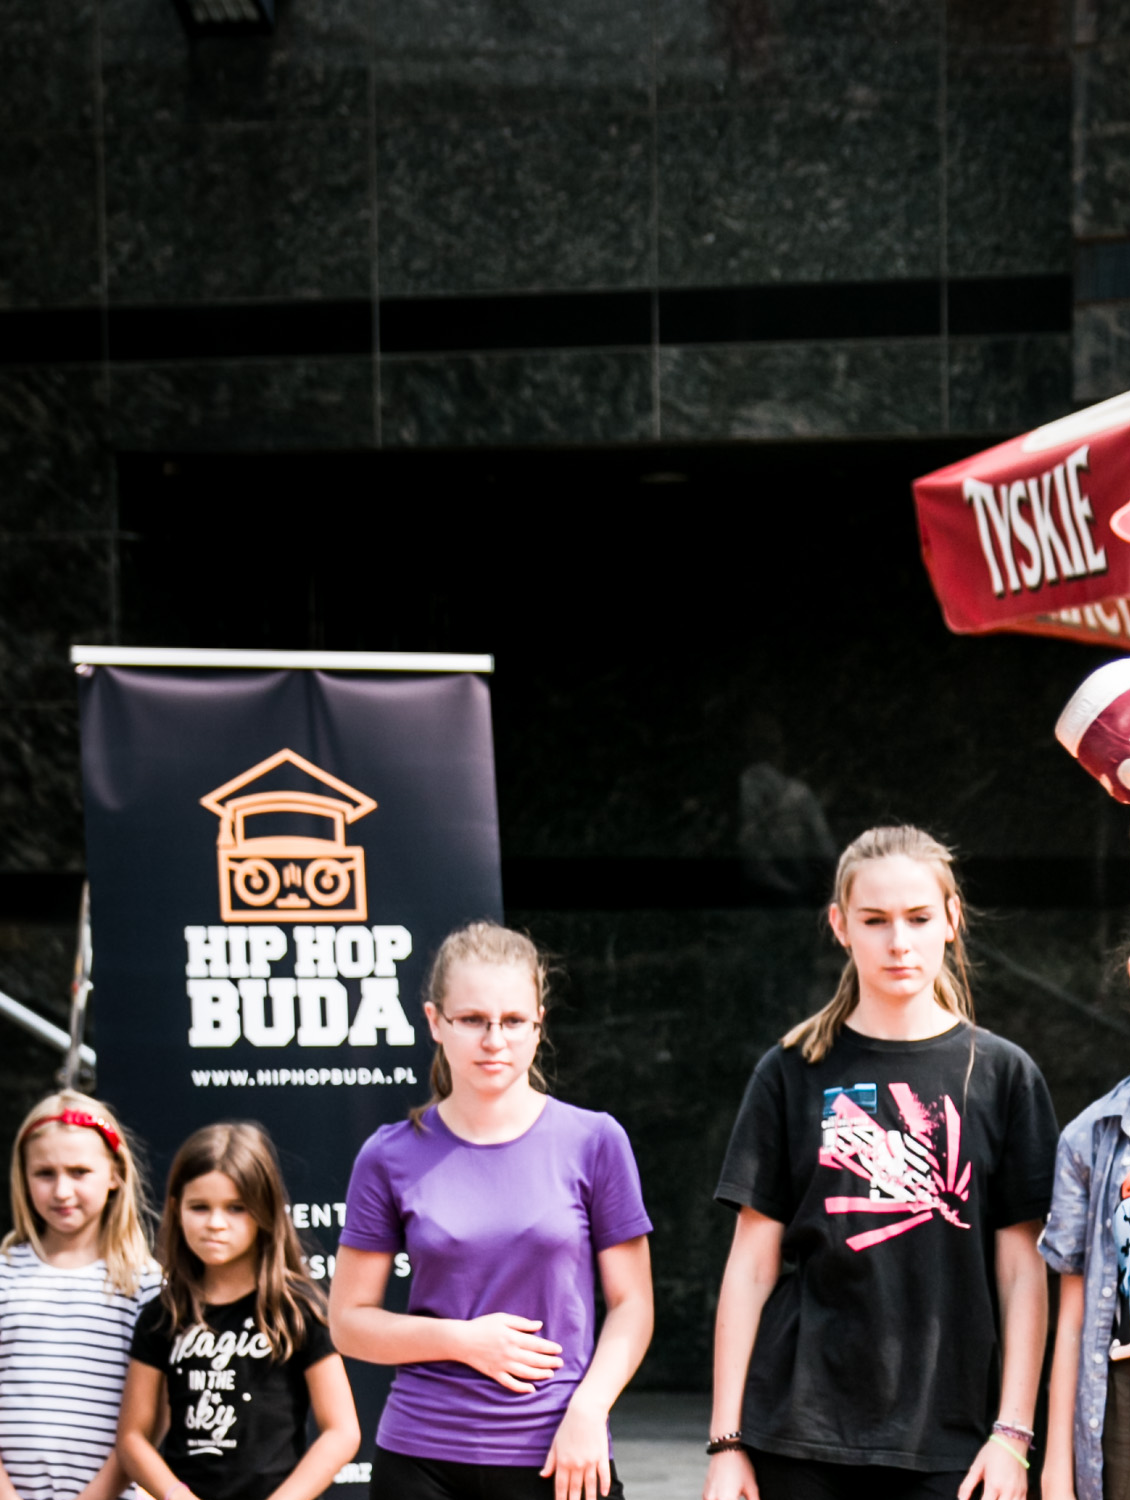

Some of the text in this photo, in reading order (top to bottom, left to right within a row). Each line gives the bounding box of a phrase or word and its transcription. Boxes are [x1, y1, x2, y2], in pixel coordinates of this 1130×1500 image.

[963, 444, 1107, 597] TYSKIE
[184, 925, 413, 978] HIP HOP
[186, 977, 415, 1047] BUDA
[191, 1067, 417, 1086] WWW.HIPHOPBUDA.PL
[168, 1317, 273, 1371] Magic
[189, 1370, 236, 1391] IN THE
[185, 1389, 237, 1441] sky
